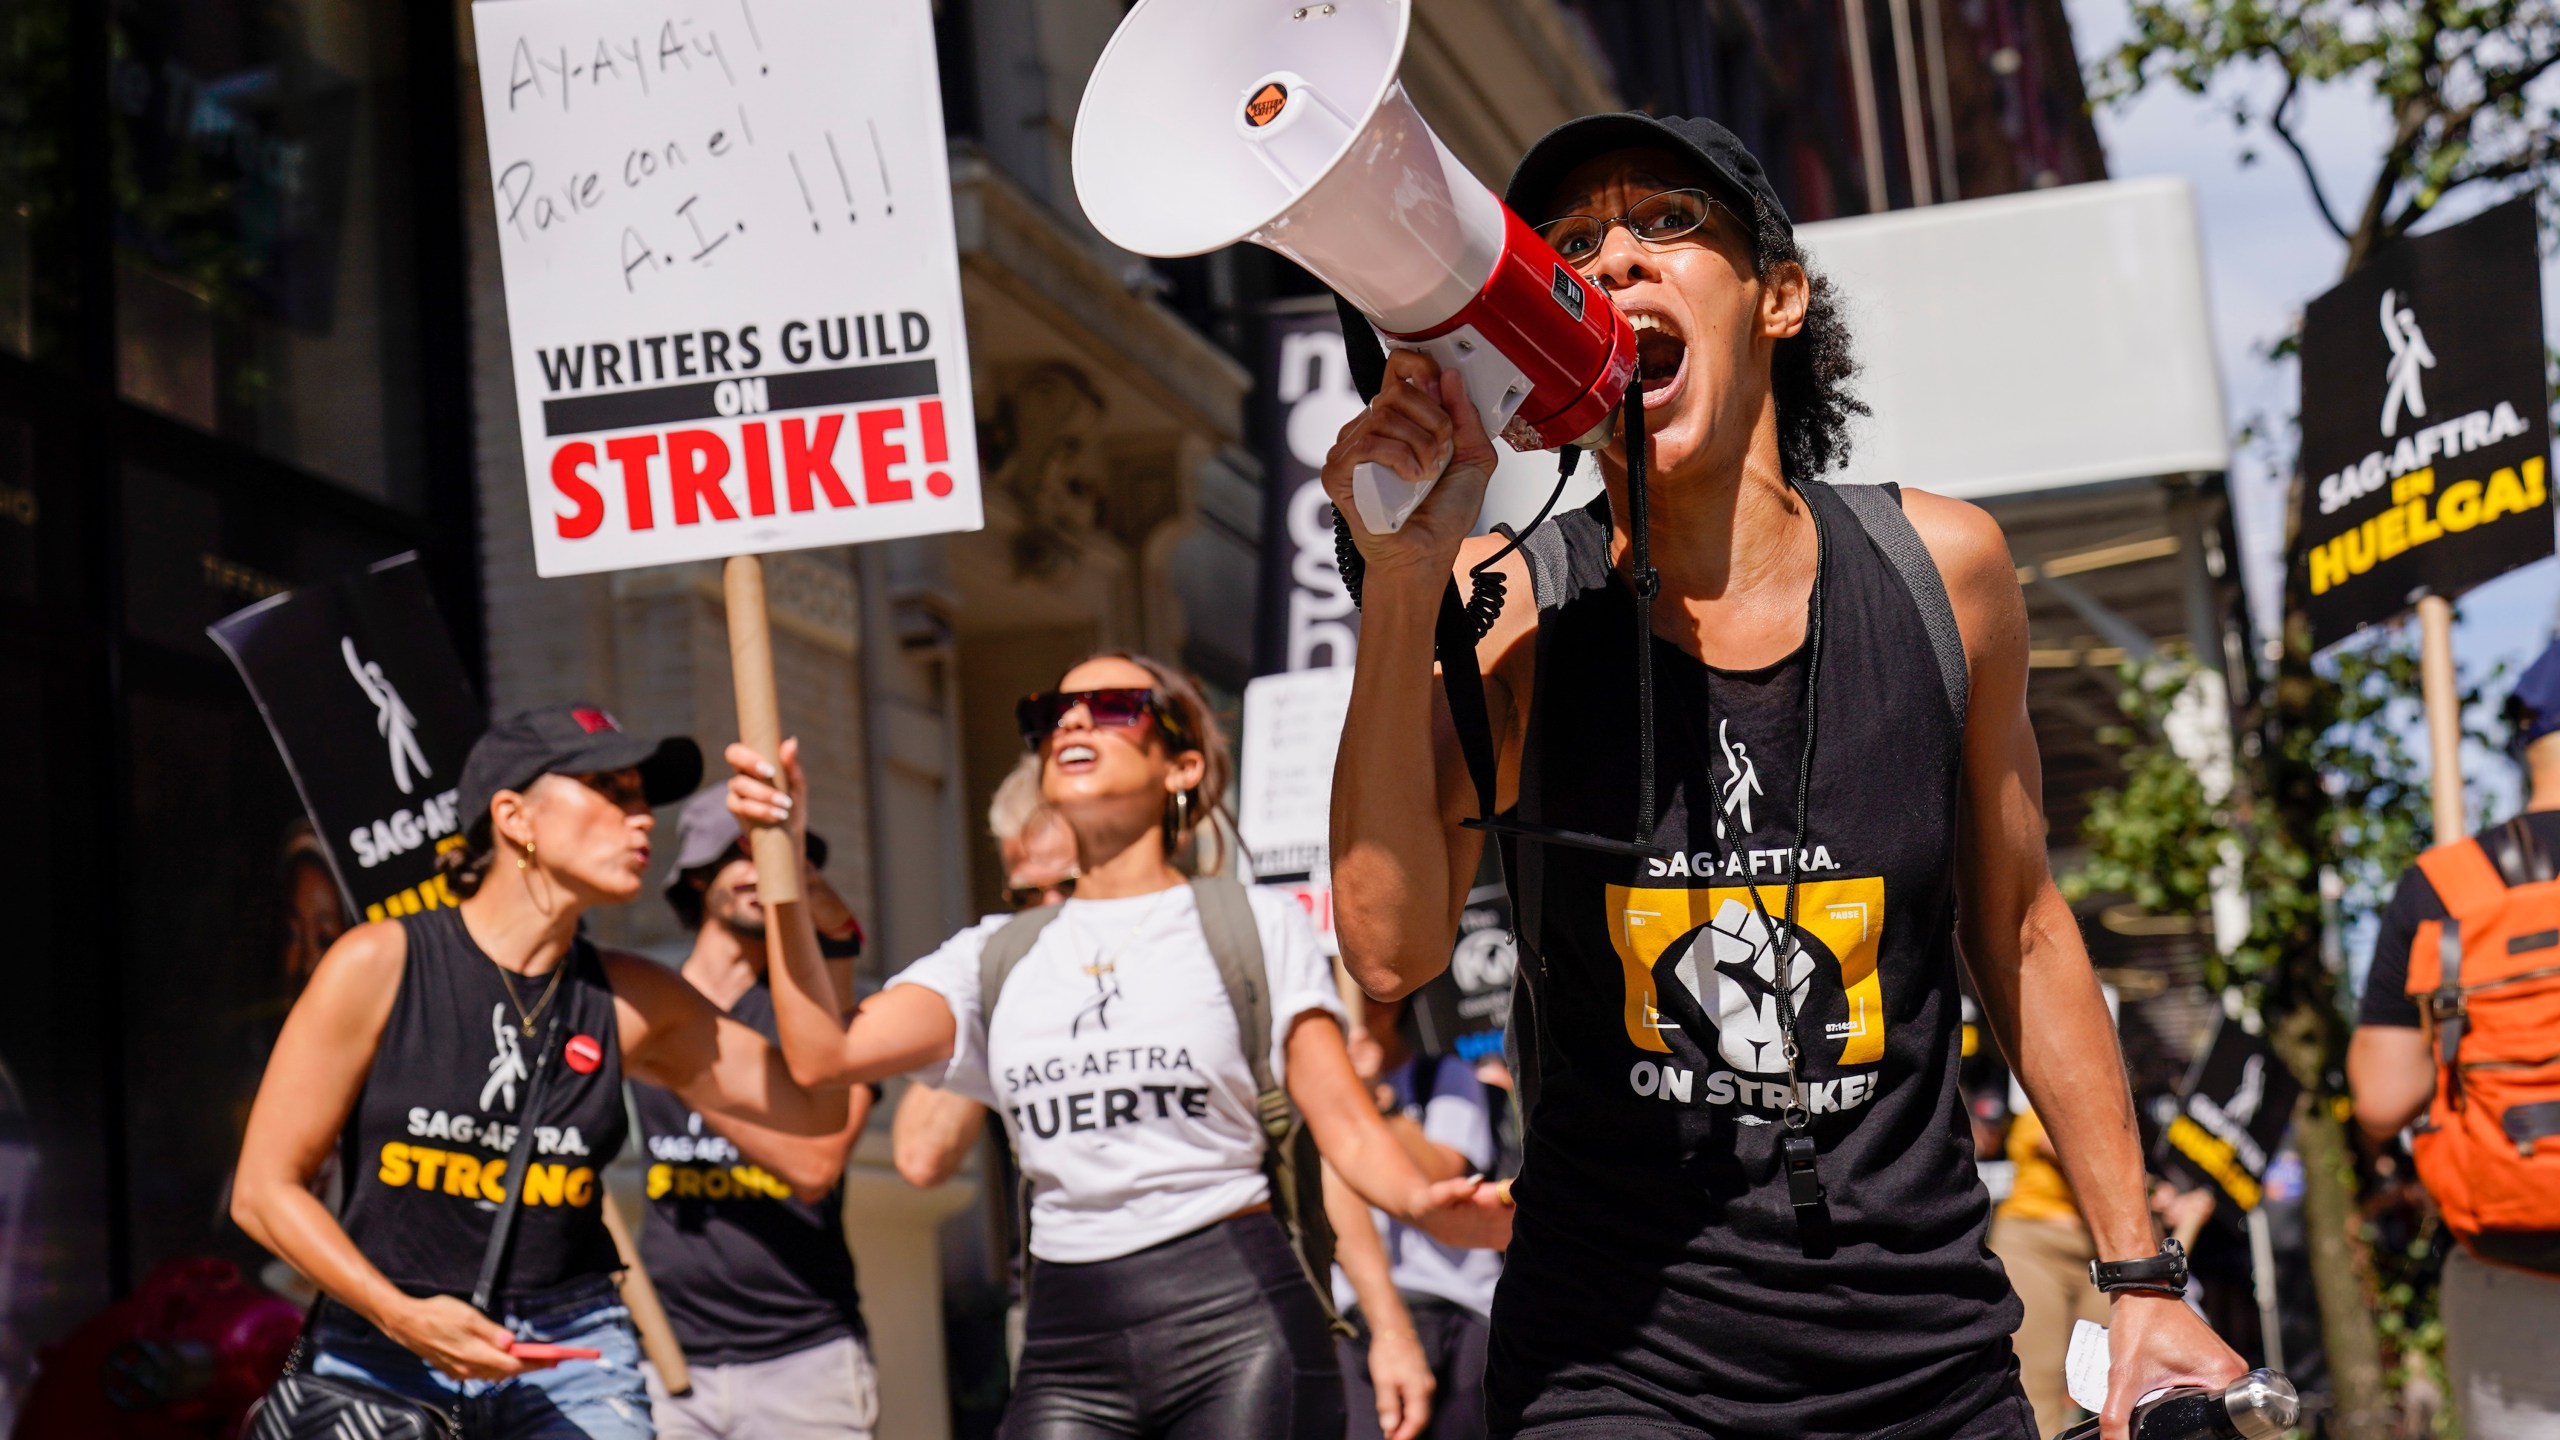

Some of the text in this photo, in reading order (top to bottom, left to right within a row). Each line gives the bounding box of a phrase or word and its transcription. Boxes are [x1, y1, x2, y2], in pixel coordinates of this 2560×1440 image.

[536, 310, 931, 392] WRITERS GUILD
[713, 379, 770, 418] ON
[550, 400, 954, 540] STRIKE!
[2391, 467, 2435, 505] EN
[2308, 455, 2547, 596] HUELGA!
[1830, 910, 1860, 920] PAUSE
[1629, 1060, 1880, 1115] ON STRIKE!
